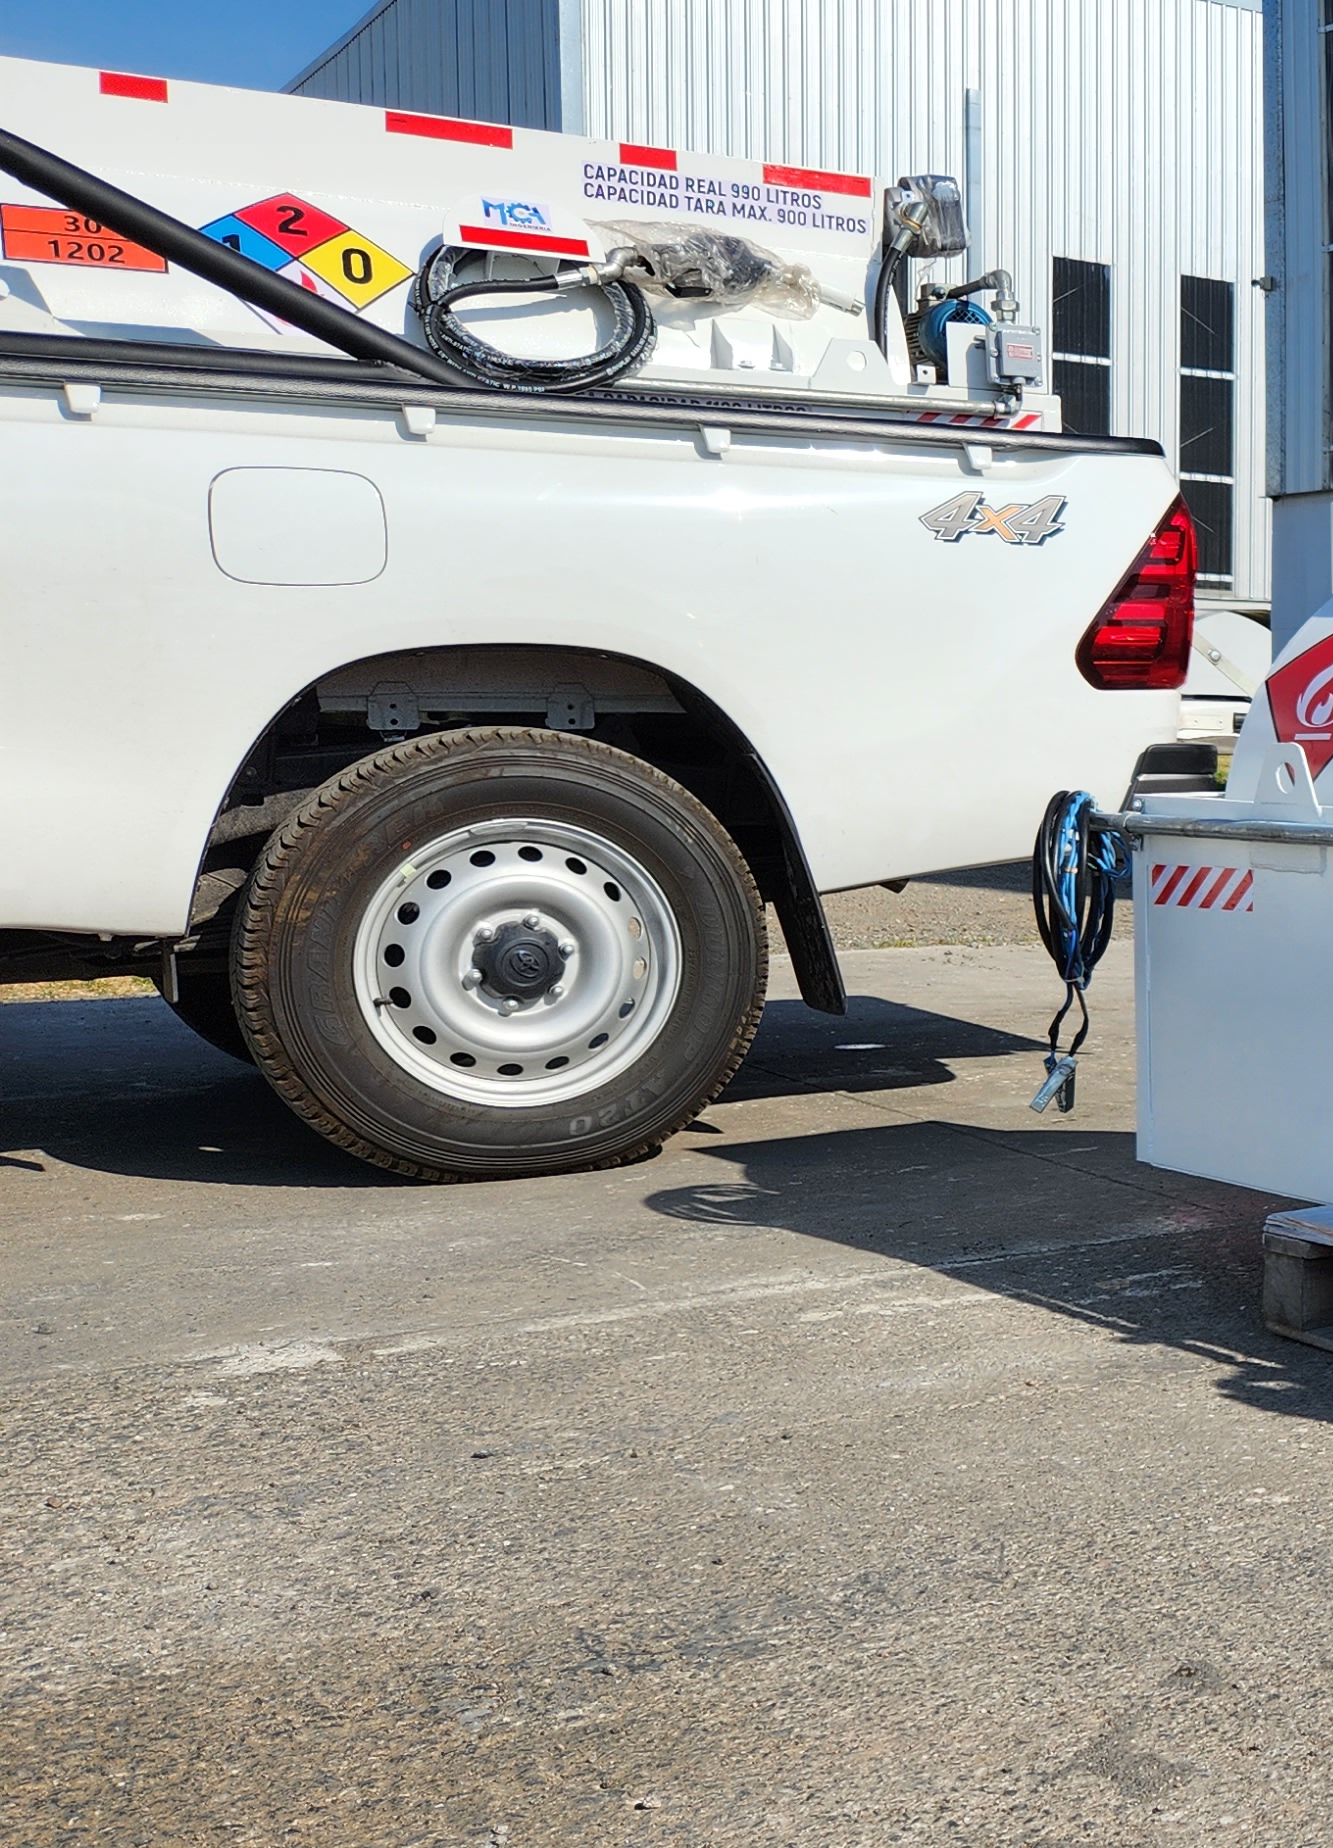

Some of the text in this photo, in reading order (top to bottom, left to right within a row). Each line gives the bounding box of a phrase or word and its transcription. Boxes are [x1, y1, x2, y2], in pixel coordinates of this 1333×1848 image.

[584, 164, 822, 209] CAPACIDAD REAL 990 LITROS
[65, 215, 102, 234] 30
[277, 206, 308, 236] 2
[584, 183, 867, 233] CAPACIDAD TARA MAX. 900 LITROS
[47, 239, 126, 264] 1202
[341, 247, 373, 285] 0
[918, 490, 1067, 544] 4x4
